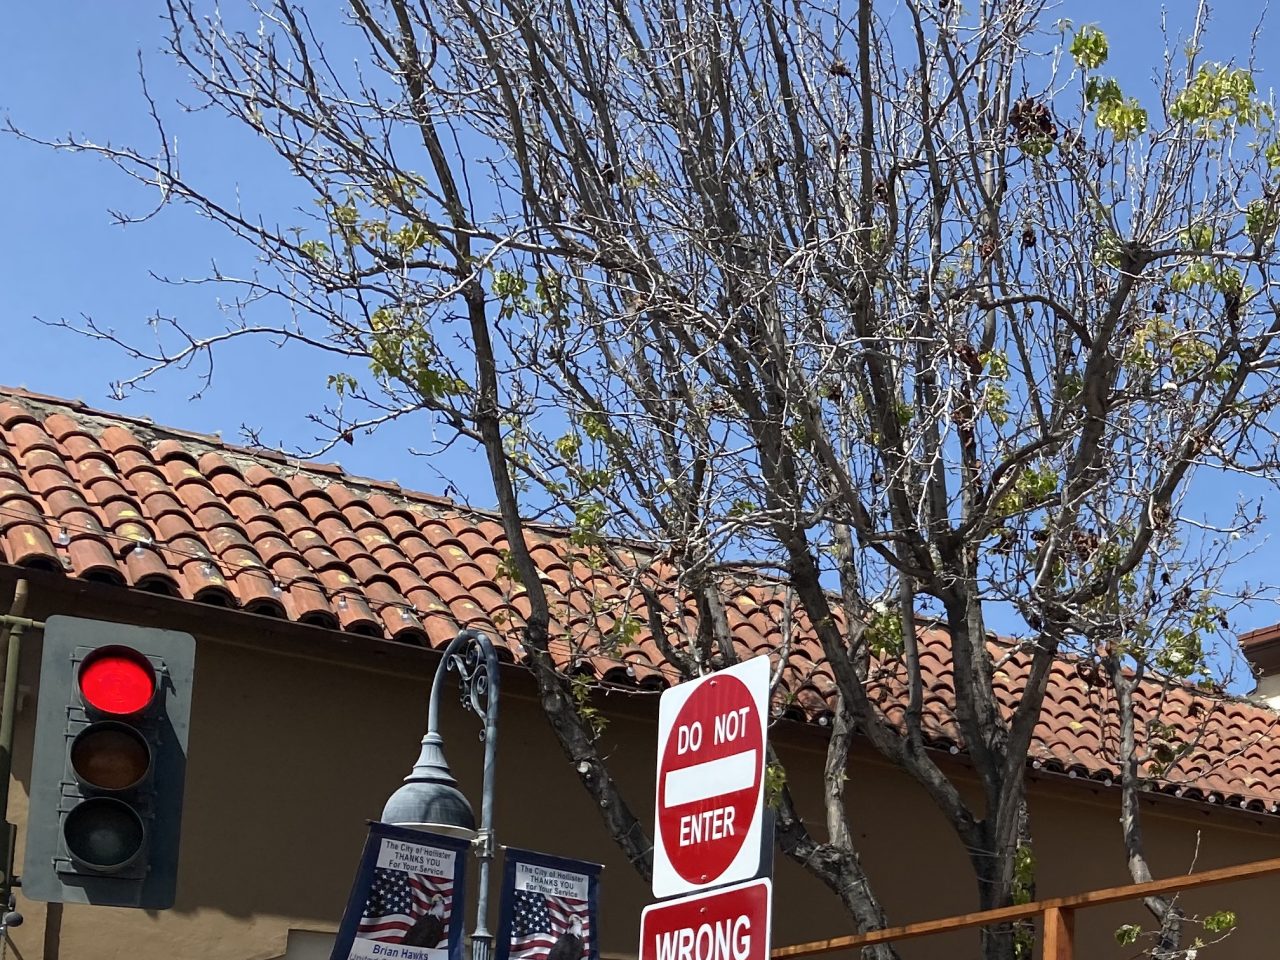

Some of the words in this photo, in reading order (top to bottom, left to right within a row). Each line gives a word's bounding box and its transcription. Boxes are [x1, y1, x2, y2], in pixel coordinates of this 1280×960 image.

[677, 721, 703, 756] DO
[713, 706, 750, 746] NOT
[679, 805, 736, 848] ENTER
[386, 841, 399, 851] The
[401, 843, 414, 854] City
[415, 847, 424, 855] of
[424, 849, 451, 860] Hollister
[395, 852, 424, 864] THANKS
[426, 857, 441, 867] YOU
[389, 860, 400, 869] For
[403, 863, 418, 872] Your
[420, 864, 444, 876] Service
[521, 865, 533, 873] The
[535, 867, 548, 877] City
[557, 871, 584, 882] Hollister
[526, 883, 537, 891] For
[538, 885, 552, 894] Your
[554, 887, 578, 898] Service
[530, 875, 558, 887] THANKS
[560, 880, 574, 890] YOU
[372, 944, 399, 957] Brian
[401, 948, 429, 960] Hawks
